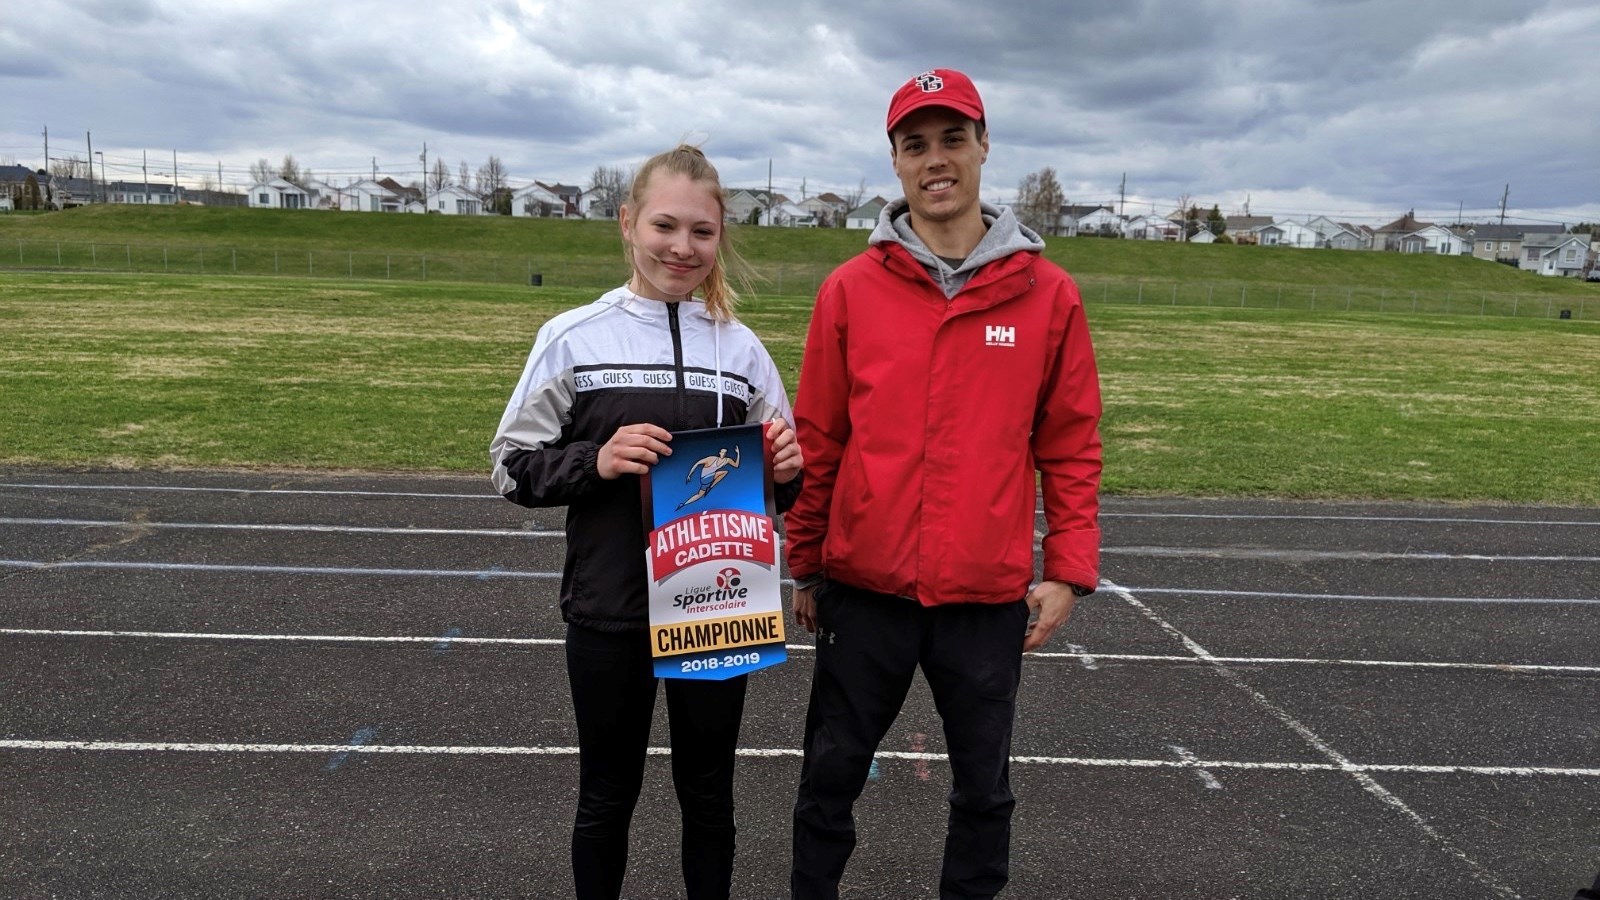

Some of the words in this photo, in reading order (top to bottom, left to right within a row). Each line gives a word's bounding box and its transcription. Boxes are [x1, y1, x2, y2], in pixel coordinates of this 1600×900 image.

[574, 374, 594, 389] ESS
[602, 372, 633, 385] GUESS
[643, 372, 672, 385] GUESS
[689, 375, 716, 389] GUESS
[724, 380, 745, 397] GUESS
[656, 510, 769, 558] ATHLÉTISME
[675, 541, 754, 567] CADETTE
[672, 587, 748, 610] Sportive
[685, 584, 712, 595] Ligue
[686, 599, 747, 614] interscolaire
[657, 616, 779, 653] CHAMPIONNE
[681, 652, 761, 673] 2018-2019
